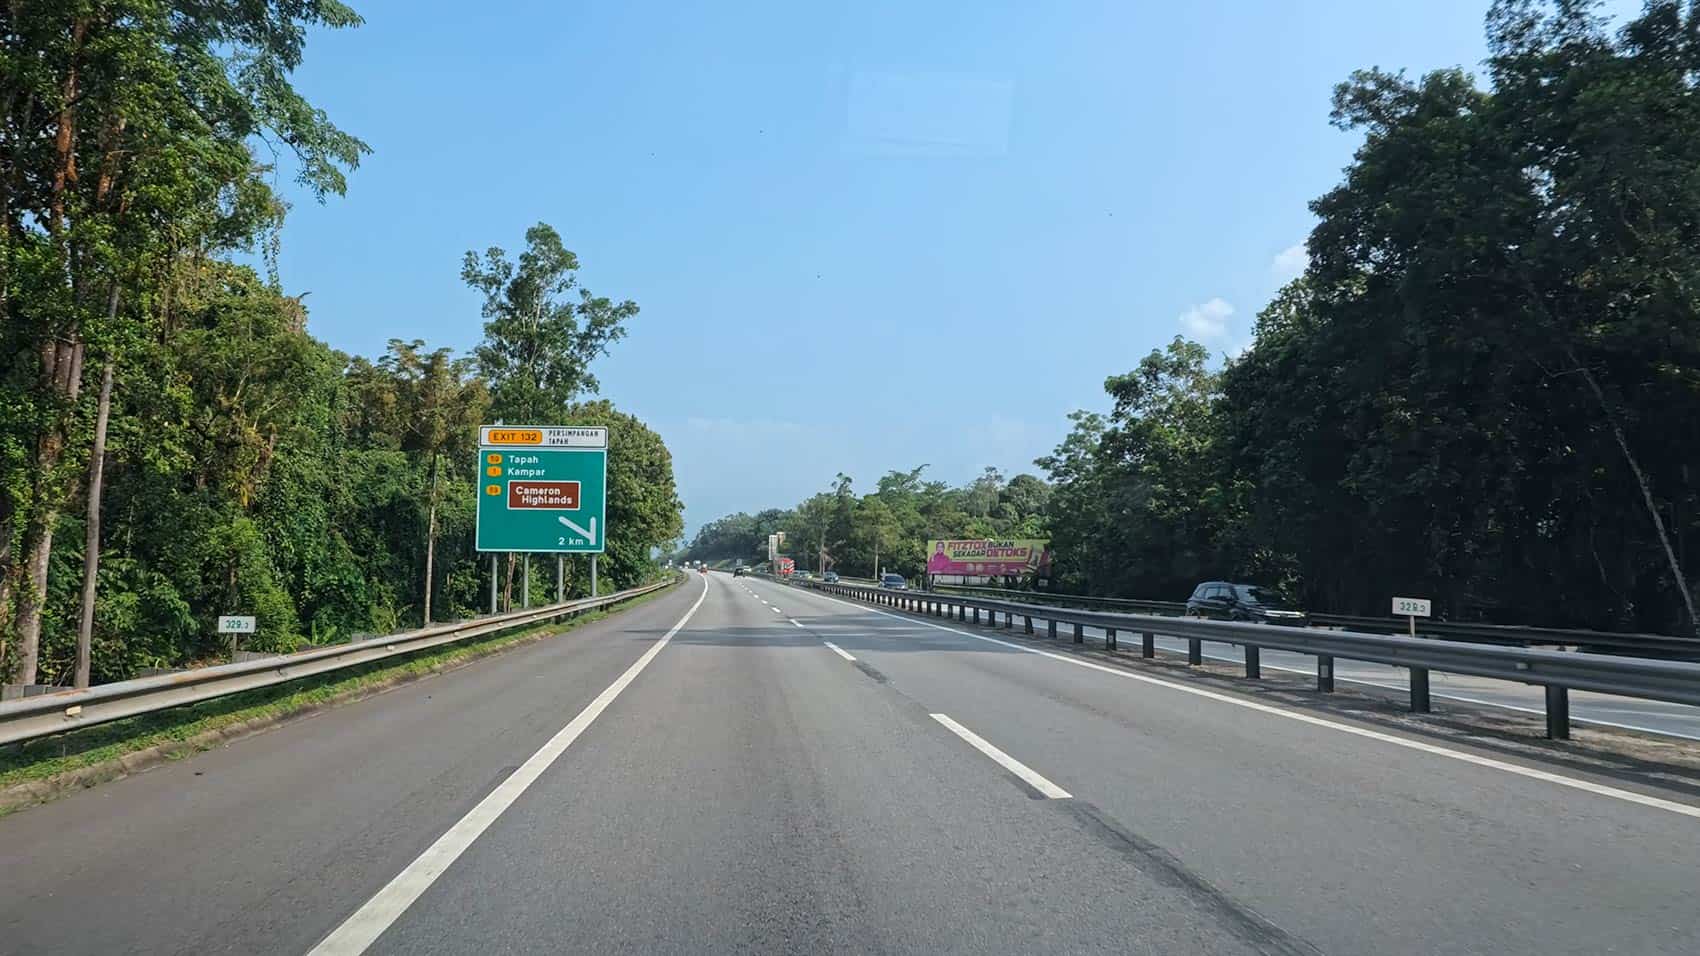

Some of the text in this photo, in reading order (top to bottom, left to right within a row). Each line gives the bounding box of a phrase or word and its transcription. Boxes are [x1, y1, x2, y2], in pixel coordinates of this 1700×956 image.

[493, 432, 537, 441] EXIT 132
[508, 455, 539, 465] Tapah
[507, 467, 546, 477] Kampar
[515, 486, 561, 495] Cameron
[521, 495, 573, 505] Highlands
[558, 537, 584, 545] 2 km
